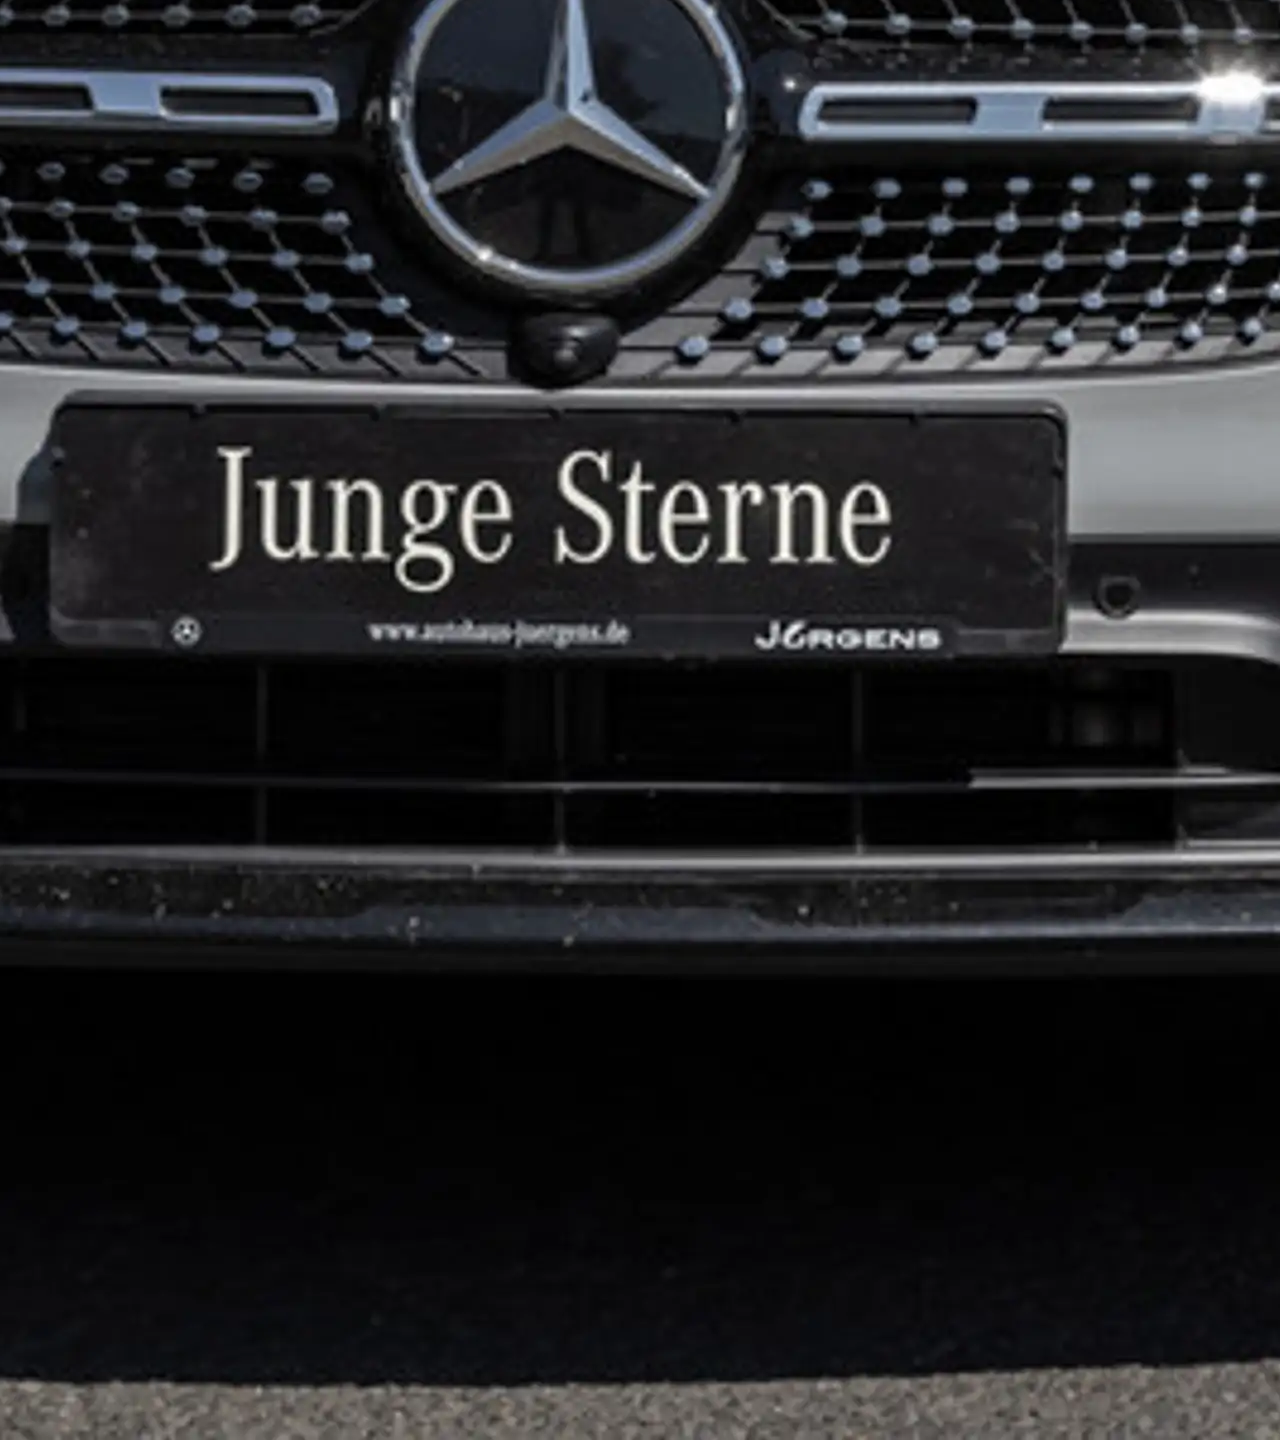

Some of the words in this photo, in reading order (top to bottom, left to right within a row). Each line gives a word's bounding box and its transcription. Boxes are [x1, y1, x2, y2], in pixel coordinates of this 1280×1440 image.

[209, 446, 512, 592] Junge
[555, 449, 891, 565] Sterne
[368, 619, 629, 648] www.autohaus-juergens.de
